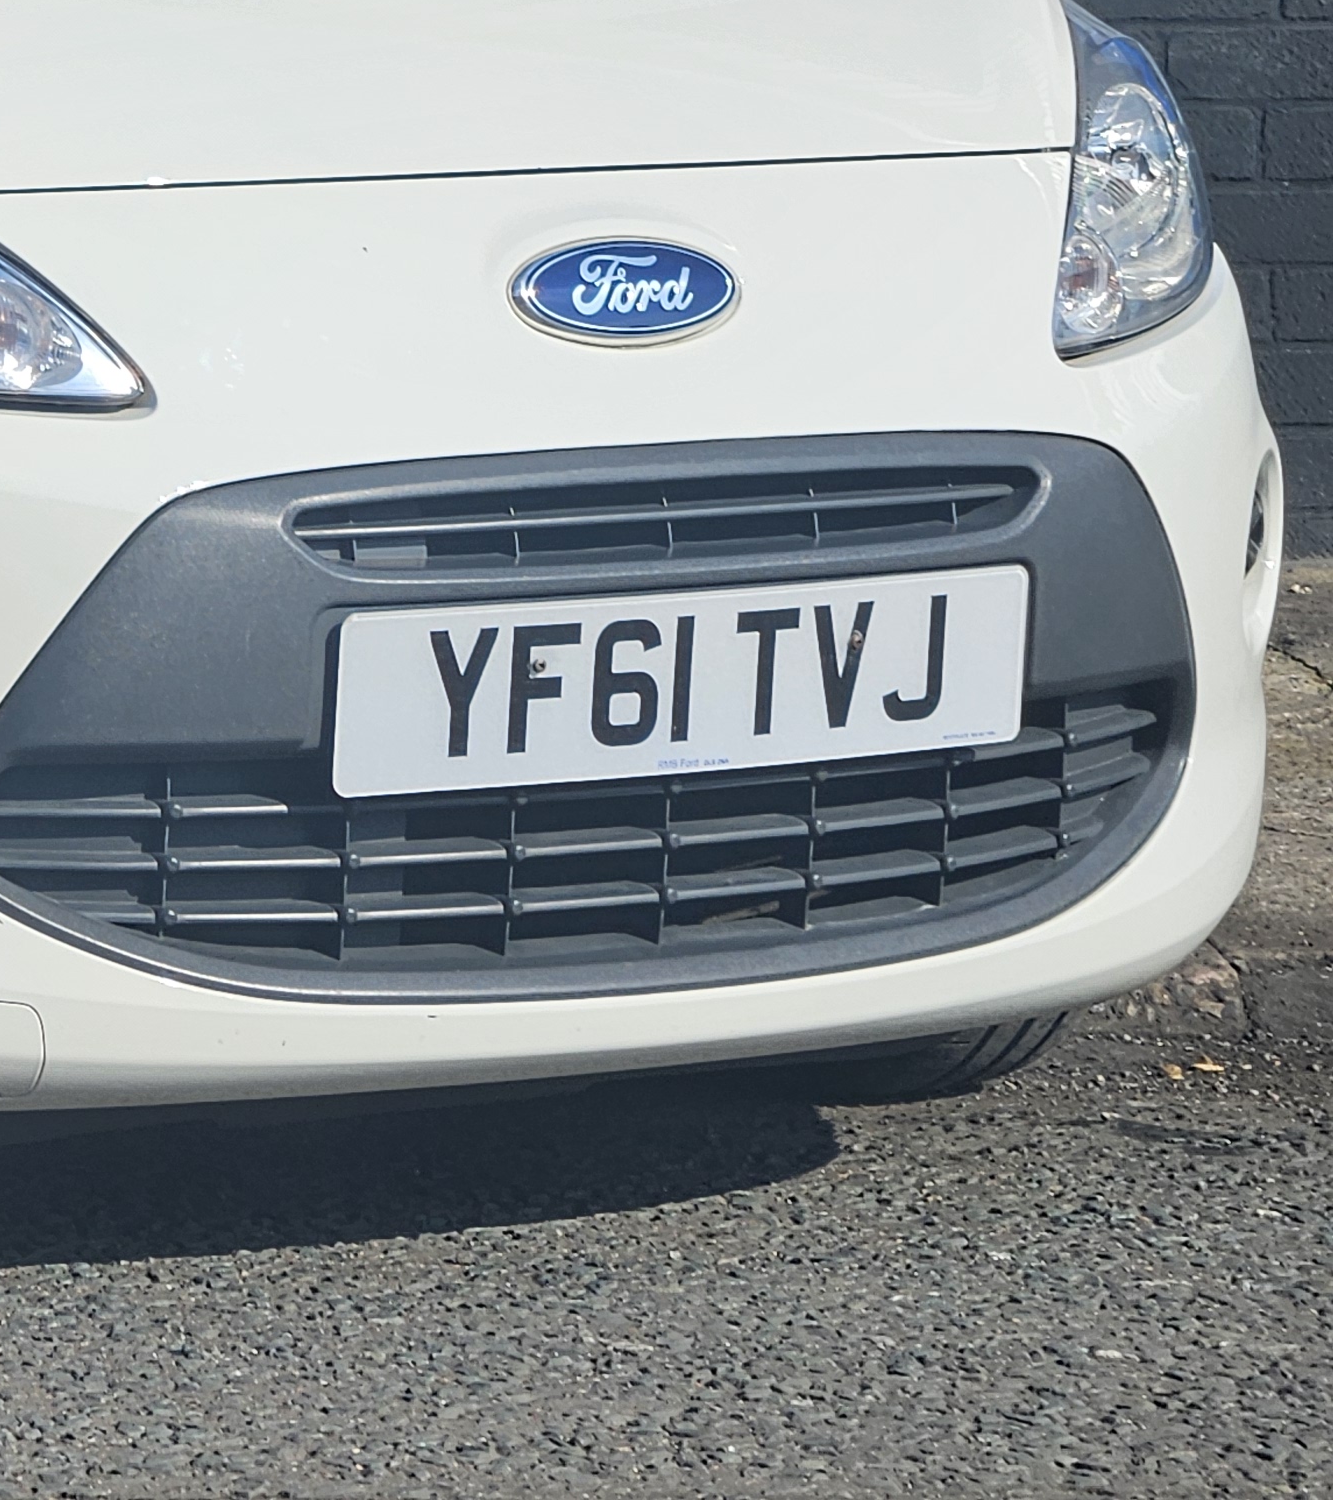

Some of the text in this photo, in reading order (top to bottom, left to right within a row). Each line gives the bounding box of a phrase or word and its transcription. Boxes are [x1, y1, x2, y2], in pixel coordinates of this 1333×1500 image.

[572, 254, 694, 316] Ford
[429, 594, 949, 758] YF61 TVJ
